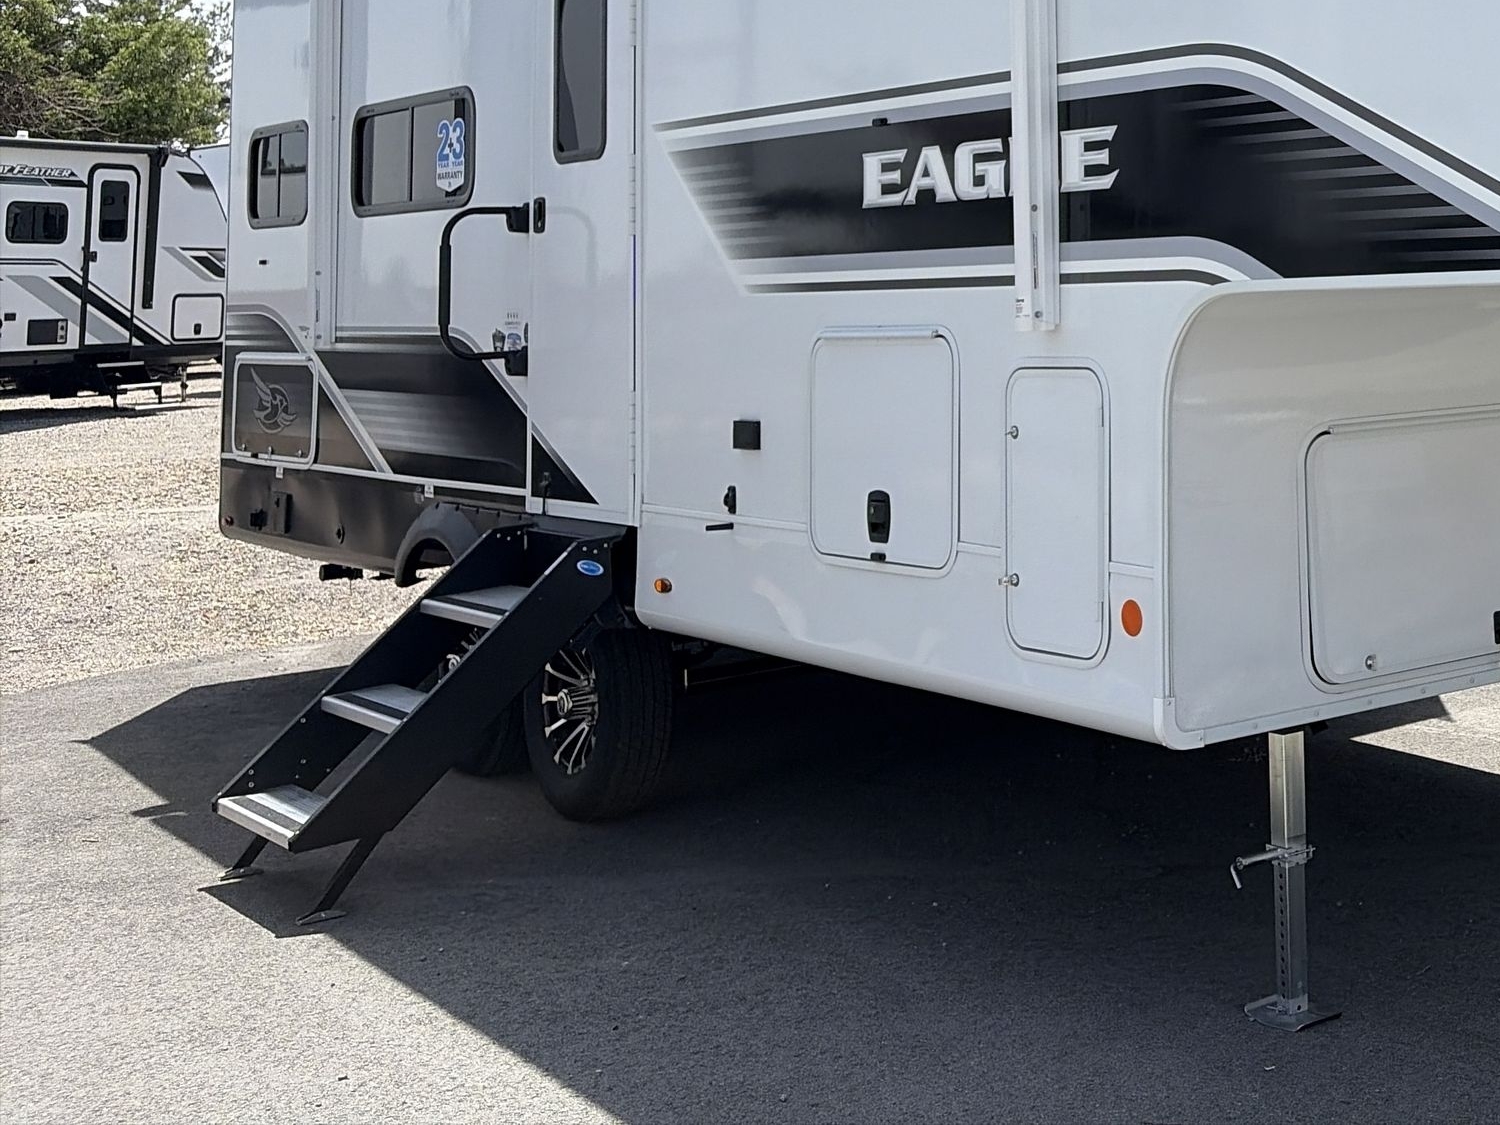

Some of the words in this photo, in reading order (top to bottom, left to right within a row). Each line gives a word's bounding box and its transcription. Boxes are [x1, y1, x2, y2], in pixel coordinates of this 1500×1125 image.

[12, 163, 73, 178] FEATHER
[862, 124, 1121, 209] EAGE
[437, 170, 463, 181] WARRANTY
